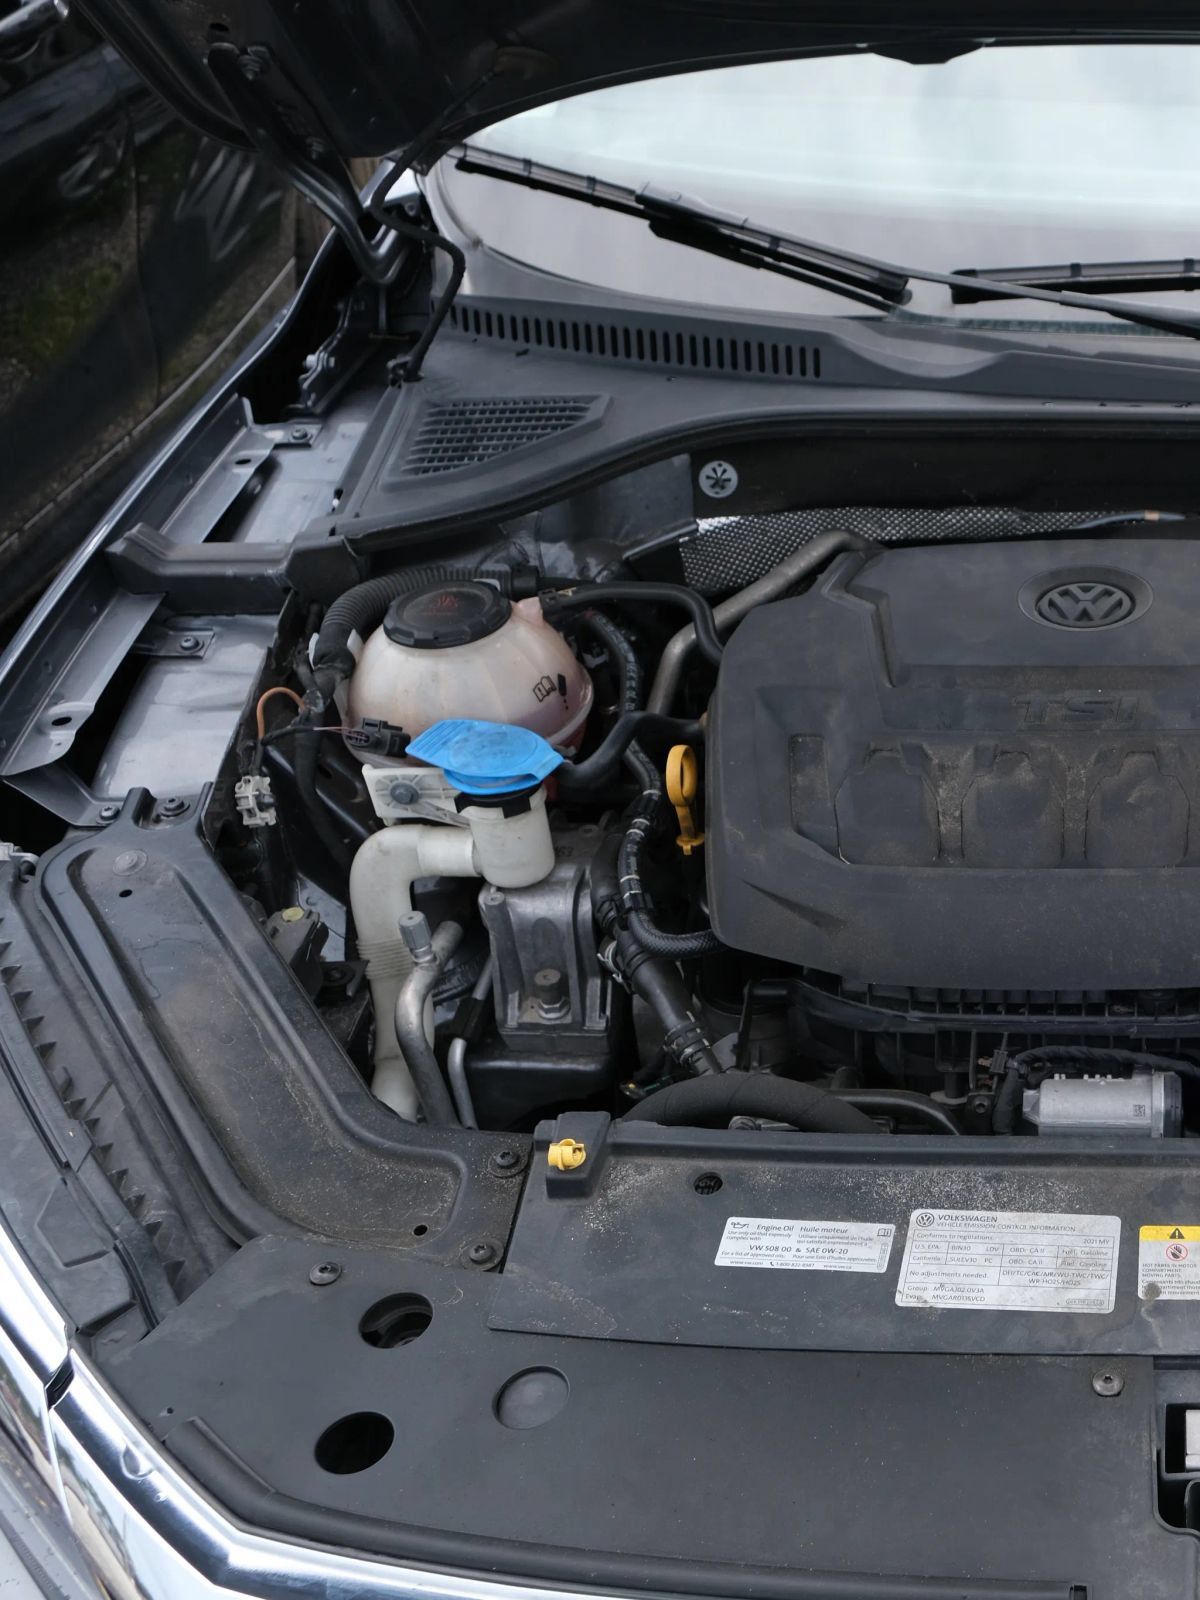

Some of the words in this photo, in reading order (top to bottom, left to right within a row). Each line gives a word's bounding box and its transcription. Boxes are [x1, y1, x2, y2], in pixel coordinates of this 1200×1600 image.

[1013, 697, 1140, 723] TSI
[938, 1214, 998, 1222] VOLKSWAGEN
[757, 1224, 782, 1232] Engine
